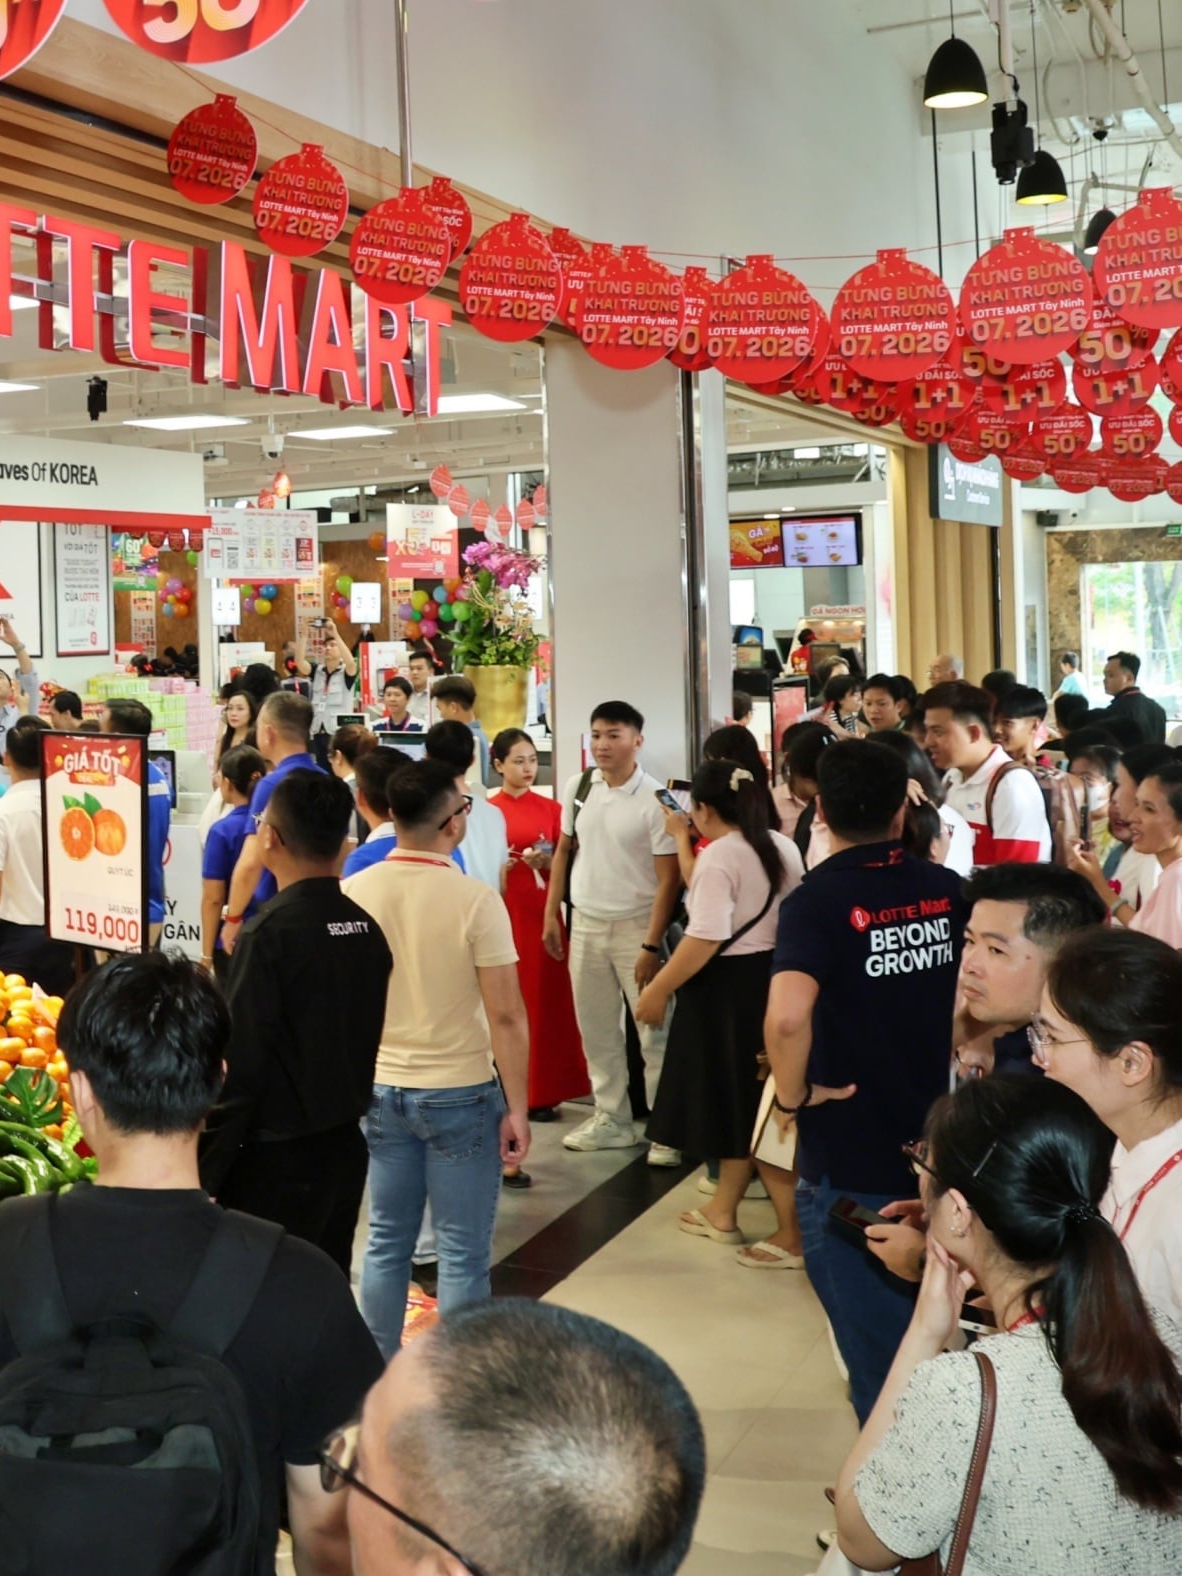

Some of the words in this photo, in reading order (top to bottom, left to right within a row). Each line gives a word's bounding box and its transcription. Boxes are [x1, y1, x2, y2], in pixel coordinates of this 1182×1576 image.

[260, 201, 283, 211] LOTTE
[283, 205, 306, 215] MART
[321, 213, 338, 222] Ninh
[358, 246, 383, 257] LOTTE
[383, 251, 406, 261] MART
[422, 259, 441, 268] Ninh
[1105, 251, 1146, 269] KHAI
[1106, 271, 1141, 283] LOTTE
[1143, 266, 1176, 278] MART
[467, 286, 494, 295] LOTTE
[494, 288, 518, 297] MART
[536, 293, 555, 301] Ninh
[970, 288, 1008, 305] KHAI
[585, 298, 618, 310] KHAI
[841, 307, 877, 321] KHAI
[971, 307, 1004, 319] LOTTE
[1006, 303, 1037, 314] MART
[1060, 298, 1084, 308] Ninh
[583, 314, 611, 323] LOTTE
[612, 315, 638, 323] MART
[658, 317, 678, 325] Ninh
[710, 310, 743, 322] KHAI
[218, 240, 452, 418] MART
[708, 327, 737, 336] LOTTE
[739, 327, 767, 336] MART
[787, 326, 809, 334] Ninh
[841, 325, 872, 334] LOTTE
[873, 323, 903, 332] MART
[925, 321, 948, 329] Ninh
[914, 381, 964, 409] 1+1
[1003, 382, 1056, 410] 1+1
[1093, 372, 1149, 404] 1+1
[31, 459, 47, 482] Of
[49, 462, 98, 486] KOREA
[64, 745, 90, 774] GIÁ
[90, 749, 121, 777] TỐT
[872, 905, 918, 924] LOTTE
[65, 908, 139, 944] 119,000
[326, 921, 368, 936] SECURITY
[870, 918, 950, 952] BEYOND
[865, 940, 953, 978] GROWTH
